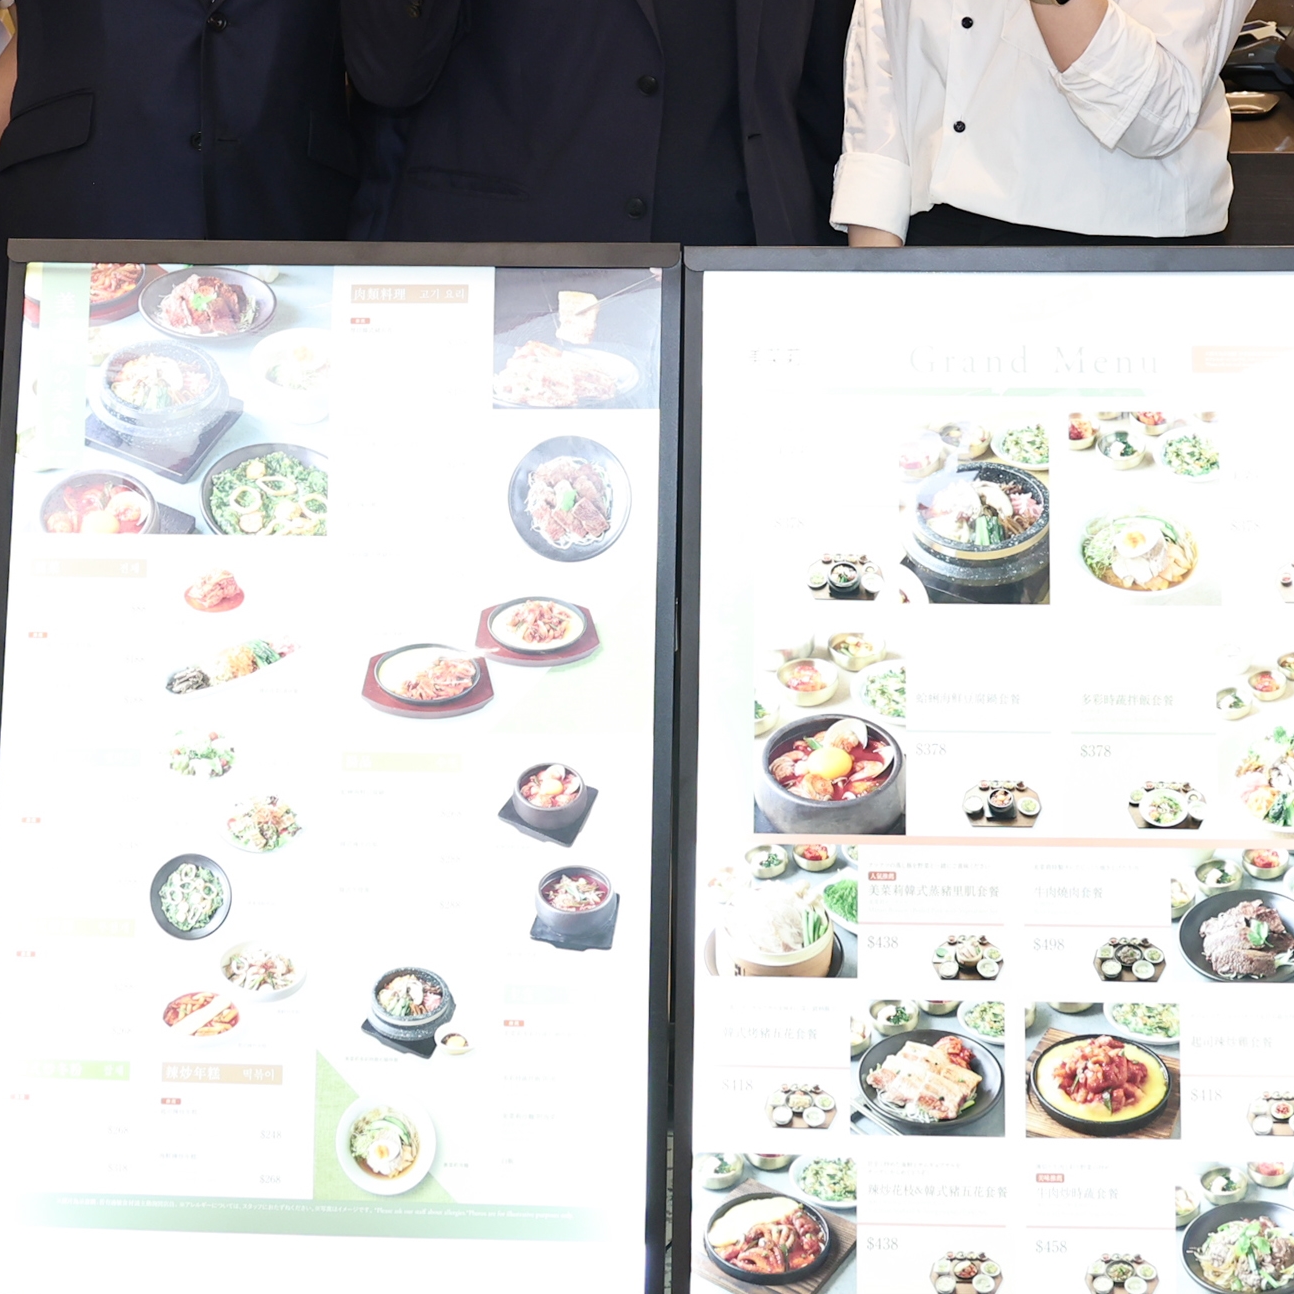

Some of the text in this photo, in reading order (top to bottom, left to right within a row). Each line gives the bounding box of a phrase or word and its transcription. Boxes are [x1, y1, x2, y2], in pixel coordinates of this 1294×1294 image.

[353, 287, 465, 301] 肉類料理 고기 요리
[909, 344, 1159, 374] Grand Menu
[1081, 693, 1175, 707] 多彩時蔬拌飯套餐
[915, 742, 947, 756] $378
[1080, 744, 1112, 758] $378
[868, 884, 1000, 898] 美菜莉韓式蒸豬里肌套餐
[1033, 885, 1104, 899] 牛肉燒肉套餐
[867, 935, 899, 950] $438
[1033, 937, 1065, 952] $498
[165, 1065, 275, 1082] 辣炒年糕 떡볶이
[259, 1129, 283, 1141] $248
[259, 1174, 282, 1185] $268
[867, 1183, 1009, 1199] 辣炒花枝&韓式豬五花套餐
[1036, 1186, 1119, 1200] 牛肉炒時蔬套餐
[866, 1236, 899, 1251] $438
[1035, 1239, 1068, 1254] $458
